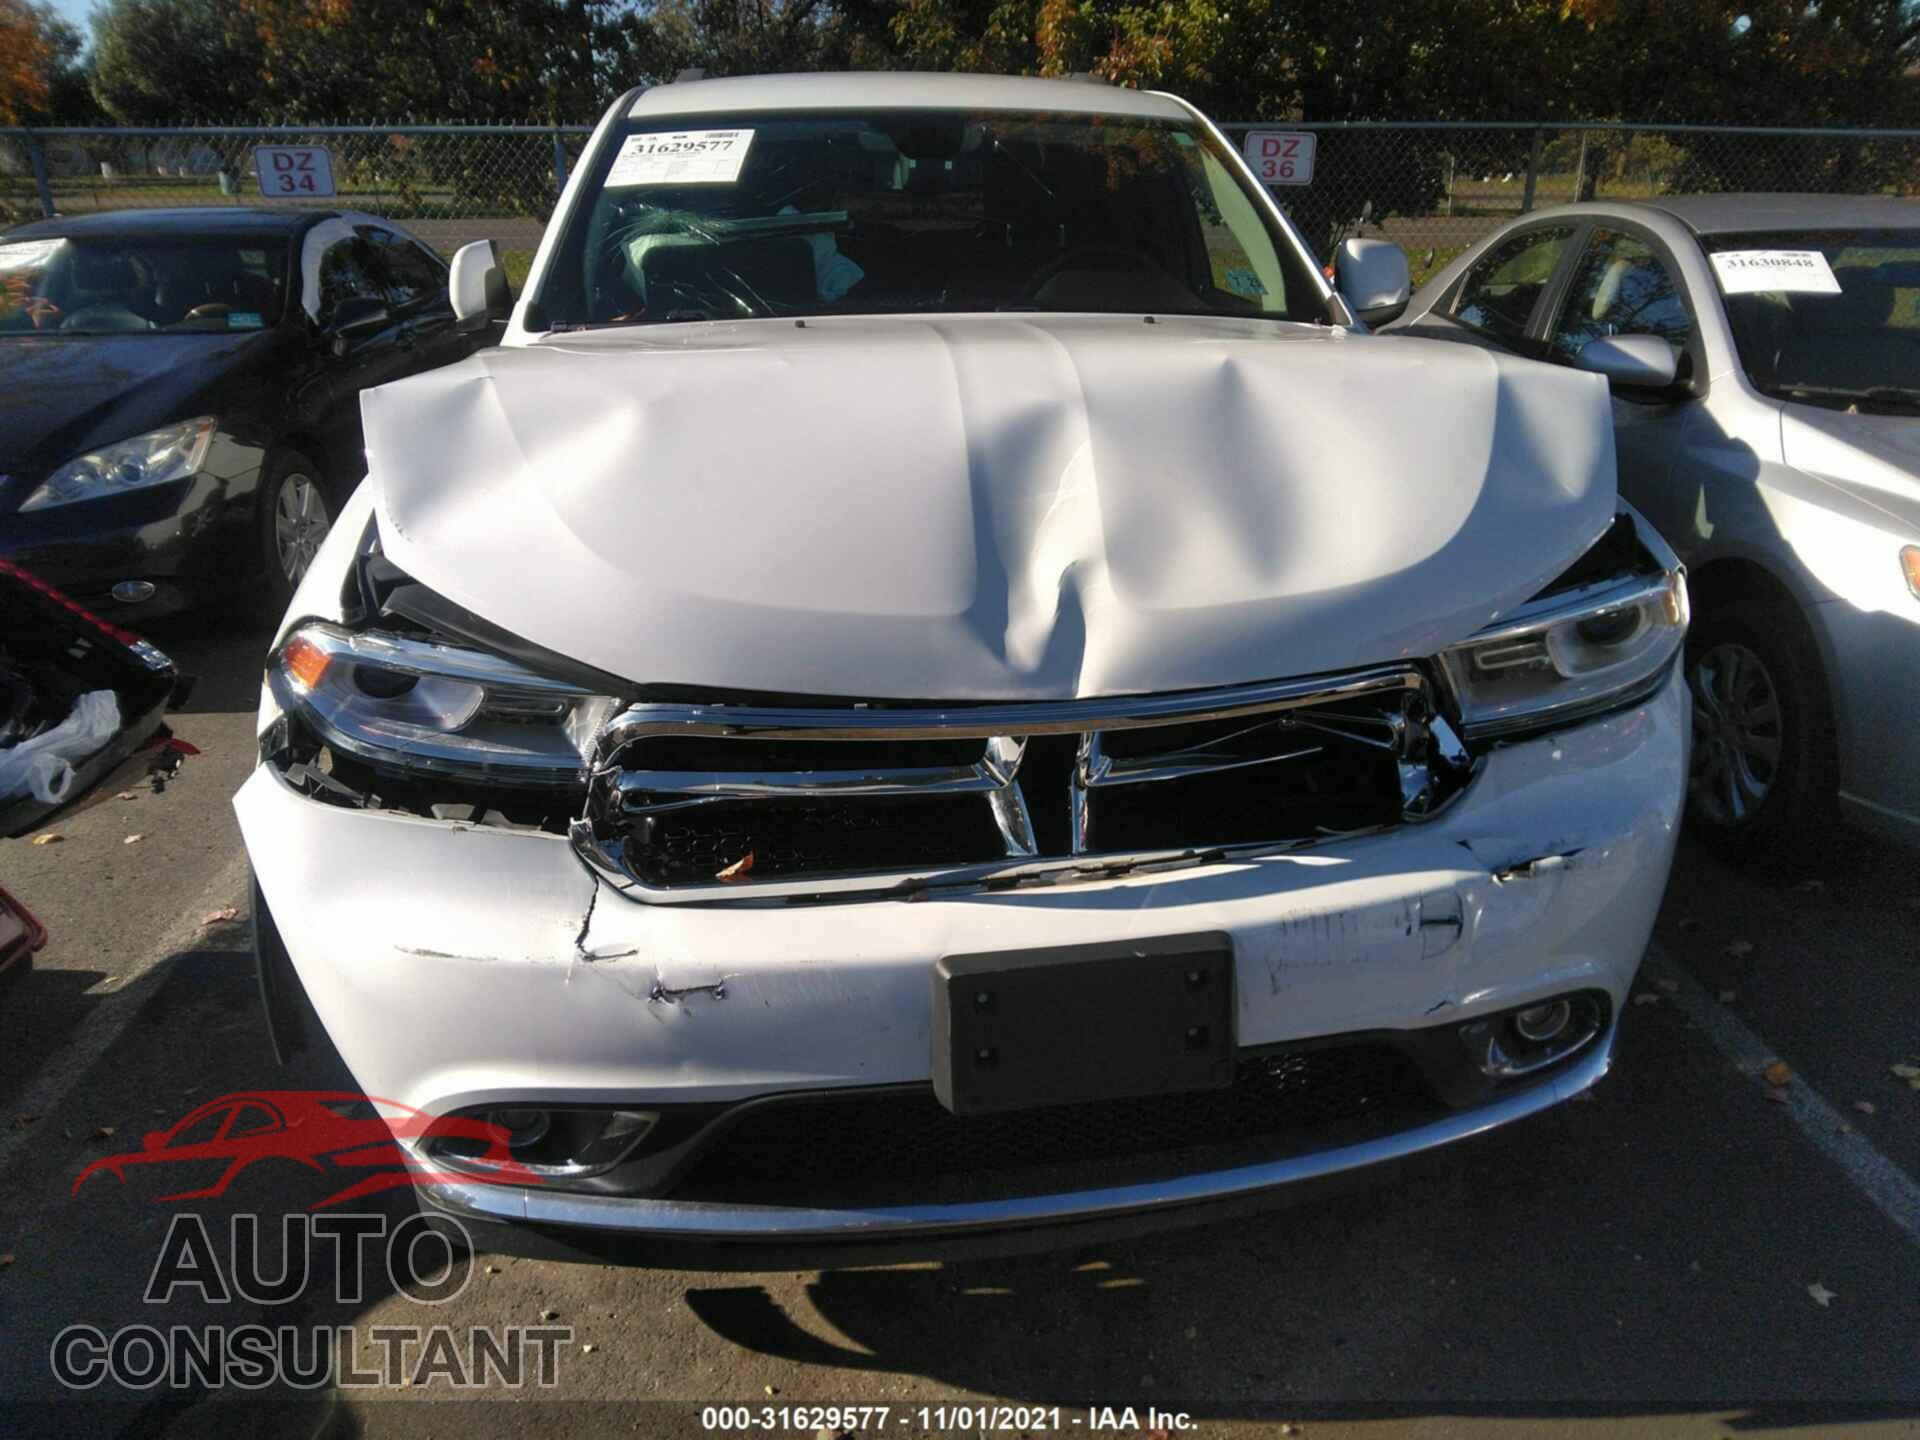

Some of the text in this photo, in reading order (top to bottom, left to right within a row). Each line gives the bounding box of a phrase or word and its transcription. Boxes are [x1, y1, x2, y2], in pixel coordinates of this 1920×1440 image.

[631, 140, 734, 154] 31629577
[1262, 138, 1300, 157] DZ
[273, 152, 315, 172] DZ
[1262, 159, 1295, 178] 36
[279, 174, 315, 192] 34
